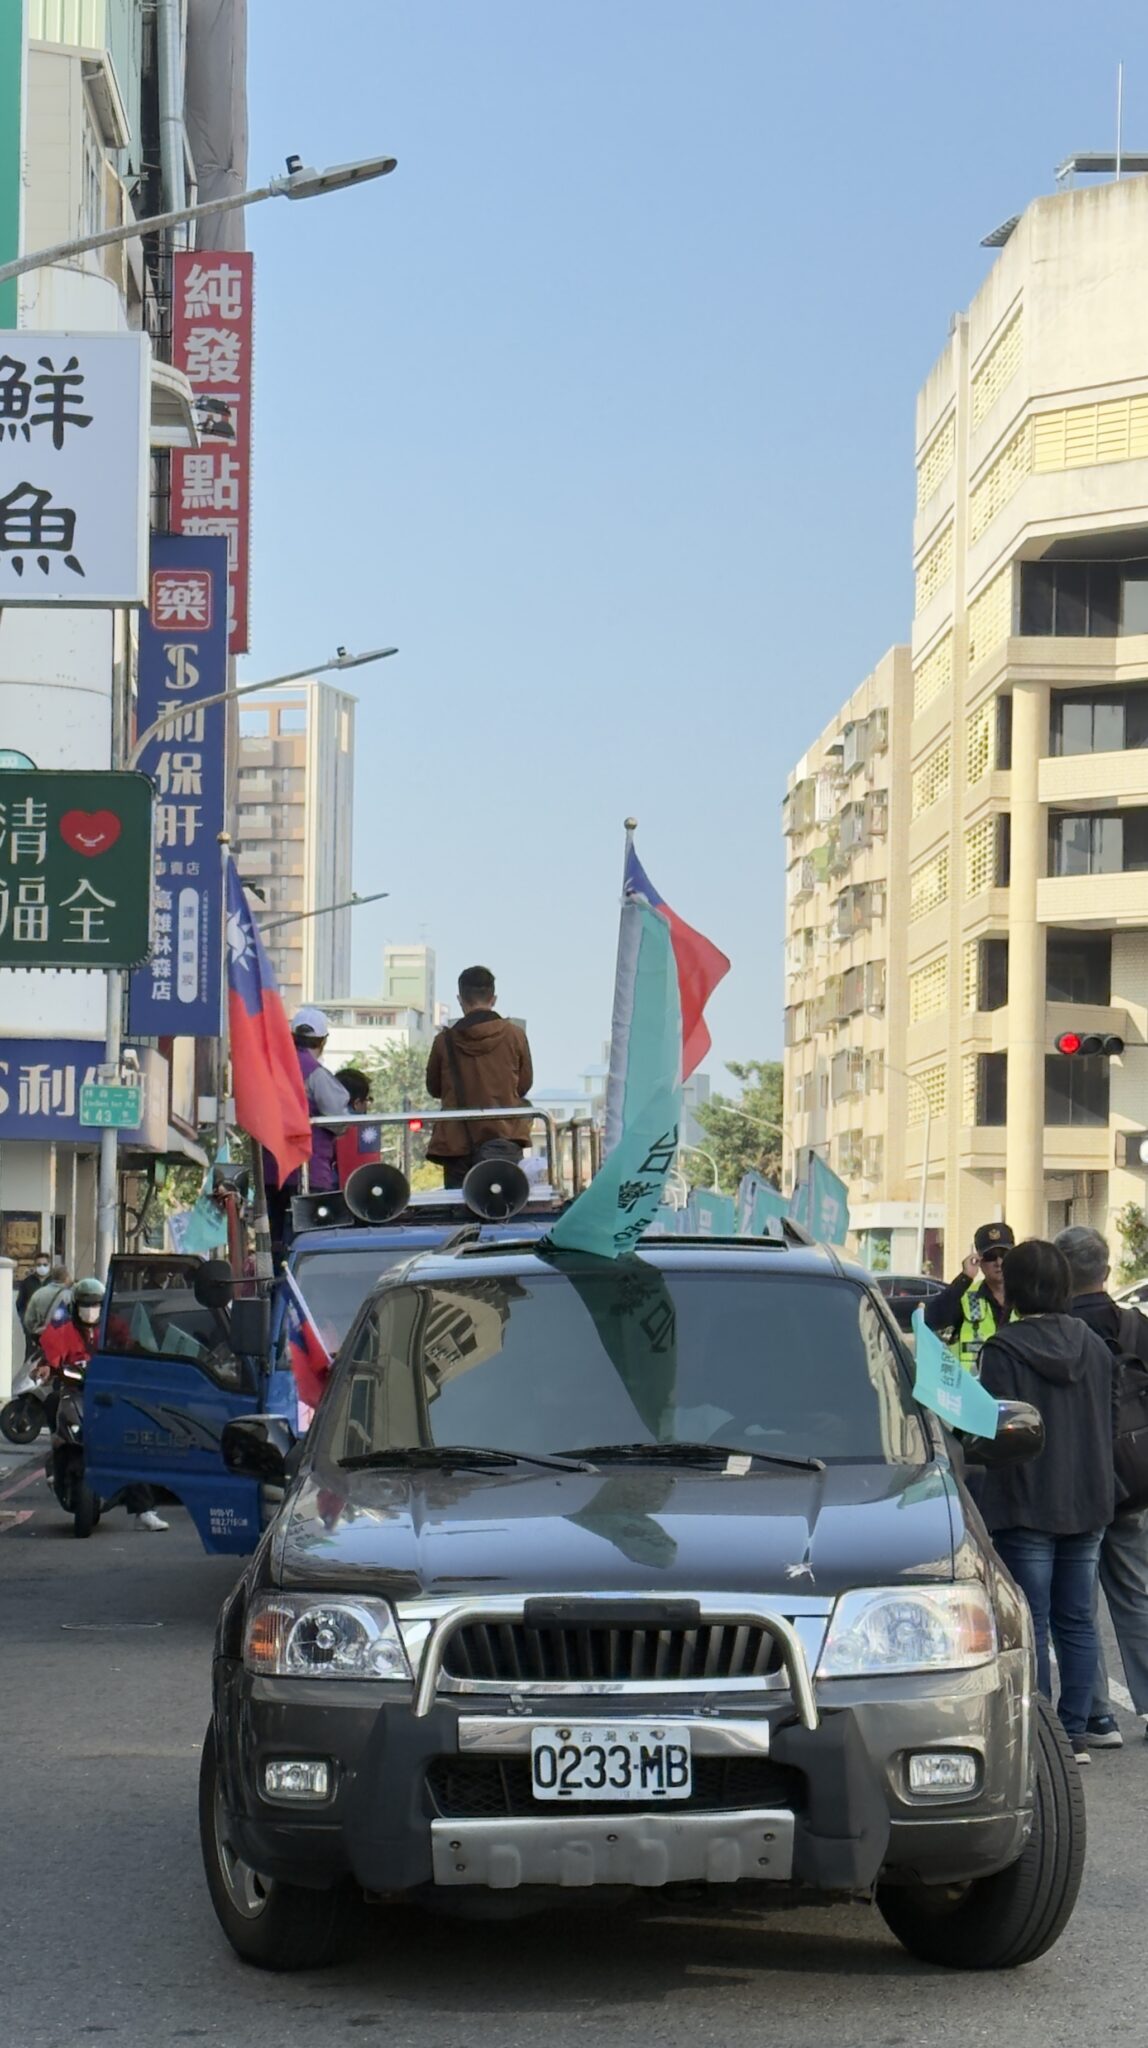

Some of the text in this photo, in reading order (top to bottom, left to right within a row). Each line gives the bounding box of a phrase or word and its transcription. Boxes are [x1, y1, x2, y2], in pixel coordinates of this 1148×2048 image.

[157, 579, 207, 621] 藥
[96, 1110, 112, 1122] 43
[581, 1731, 640, 1743] 台灣省
